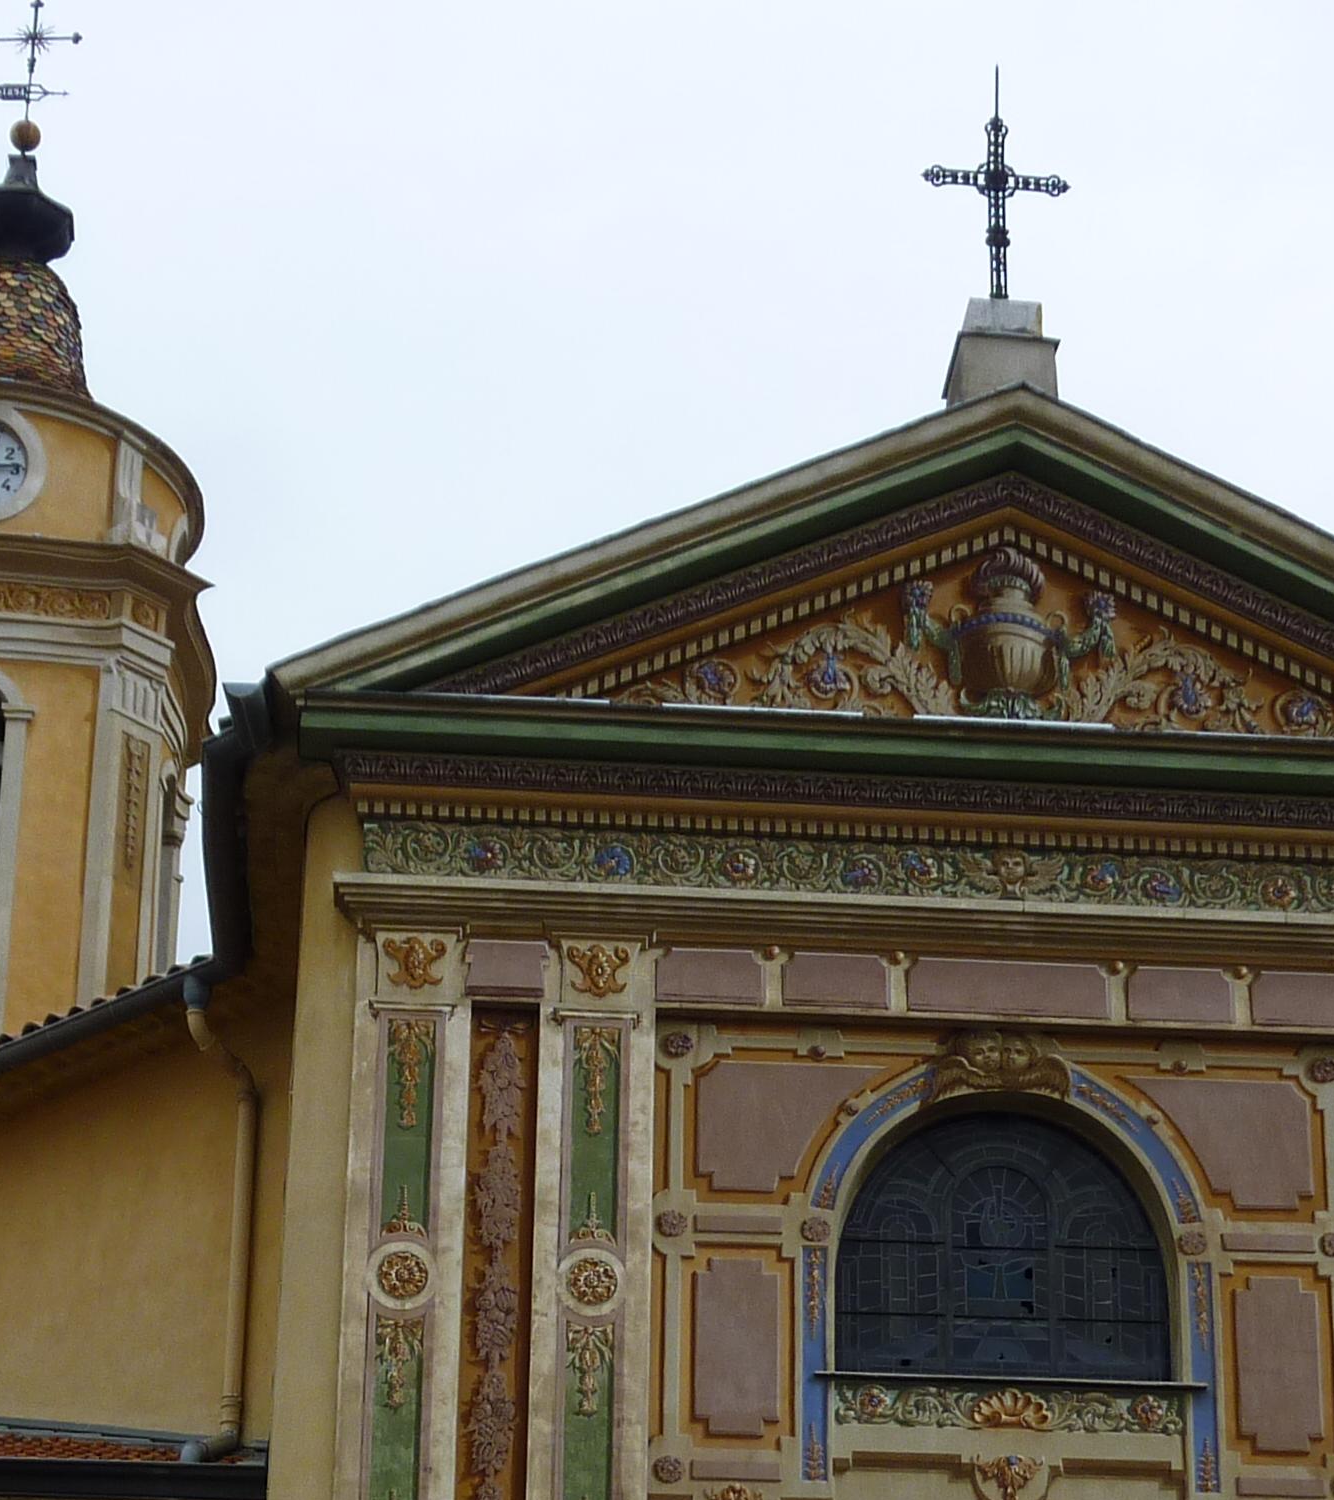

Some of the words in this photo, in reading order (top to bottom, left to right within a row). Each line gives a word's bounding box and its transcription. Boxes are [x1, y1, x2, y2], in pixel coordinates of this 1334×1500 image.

[5, 447, 16, 460] 2
[10, 462, 20, 476] 3
[1, 478, 11, 492] 4
